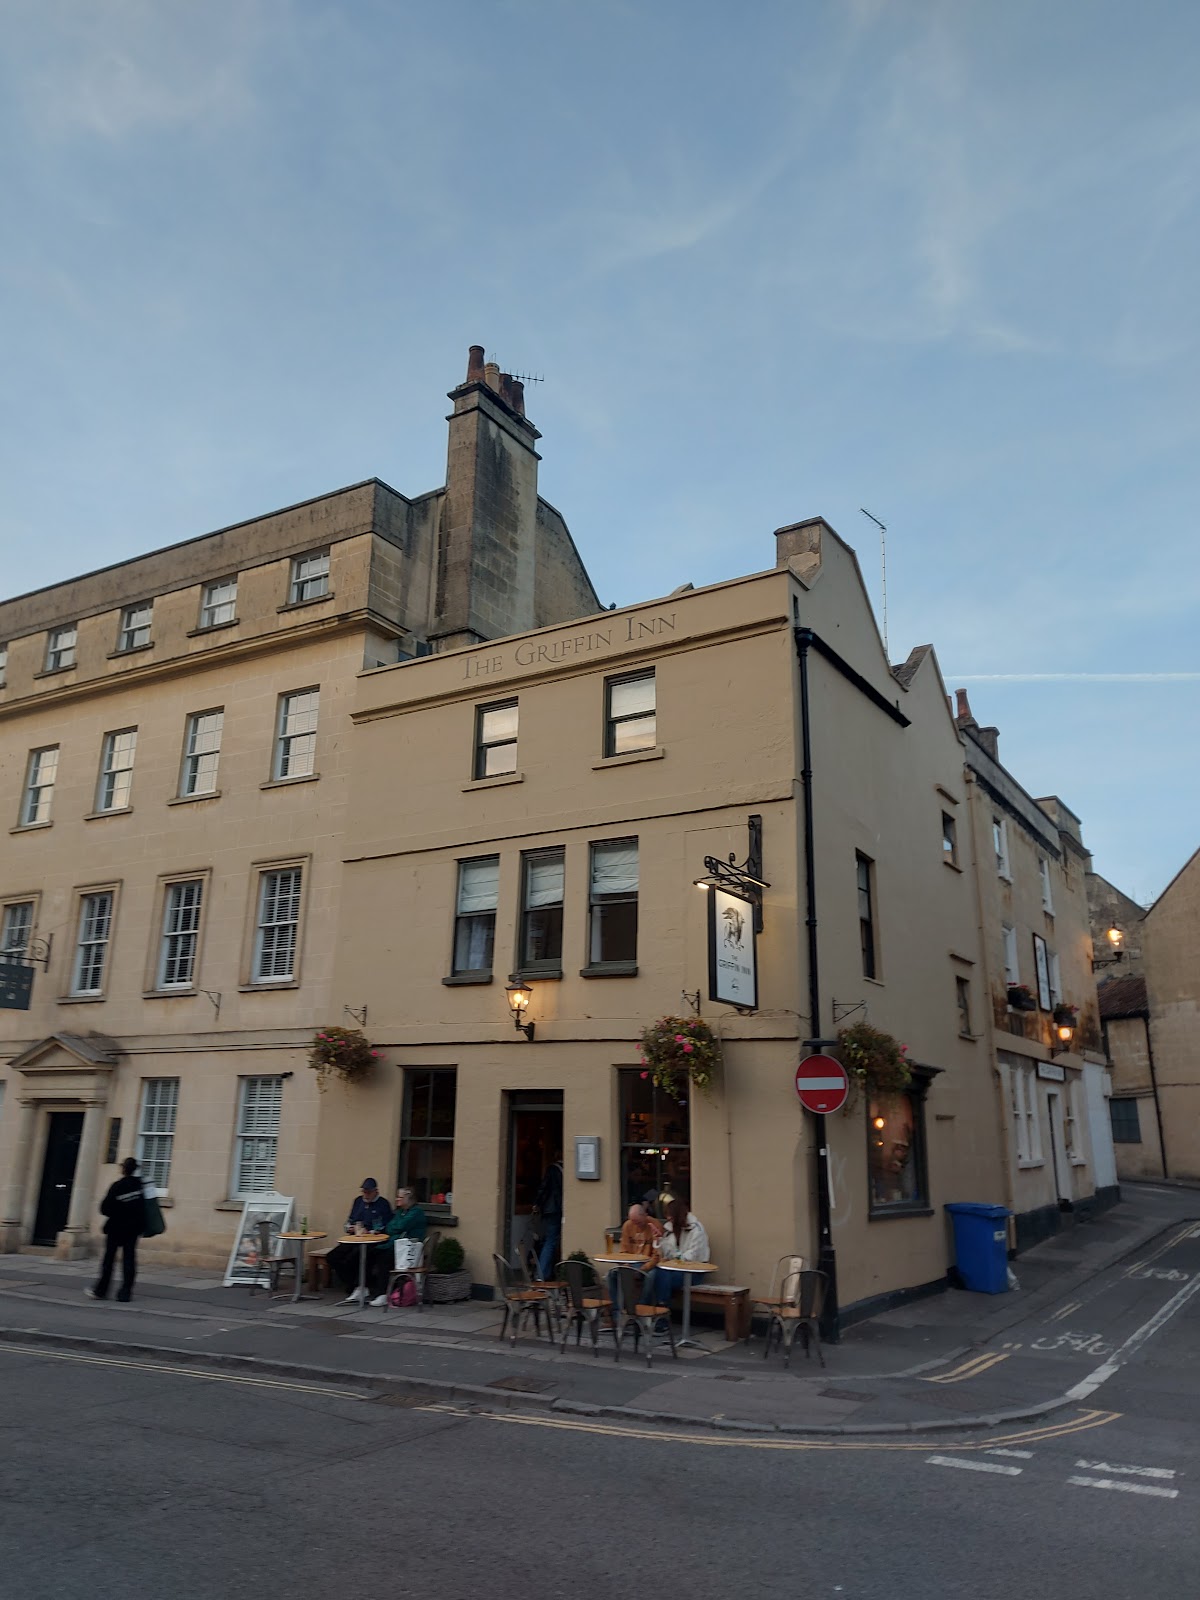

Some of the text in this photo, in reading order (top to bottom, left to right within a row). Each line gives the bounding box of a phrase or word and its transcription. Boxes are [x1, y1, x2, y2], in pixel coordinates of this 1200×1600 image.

[460, 613, 677, 680] THE GRIFFIN INN
